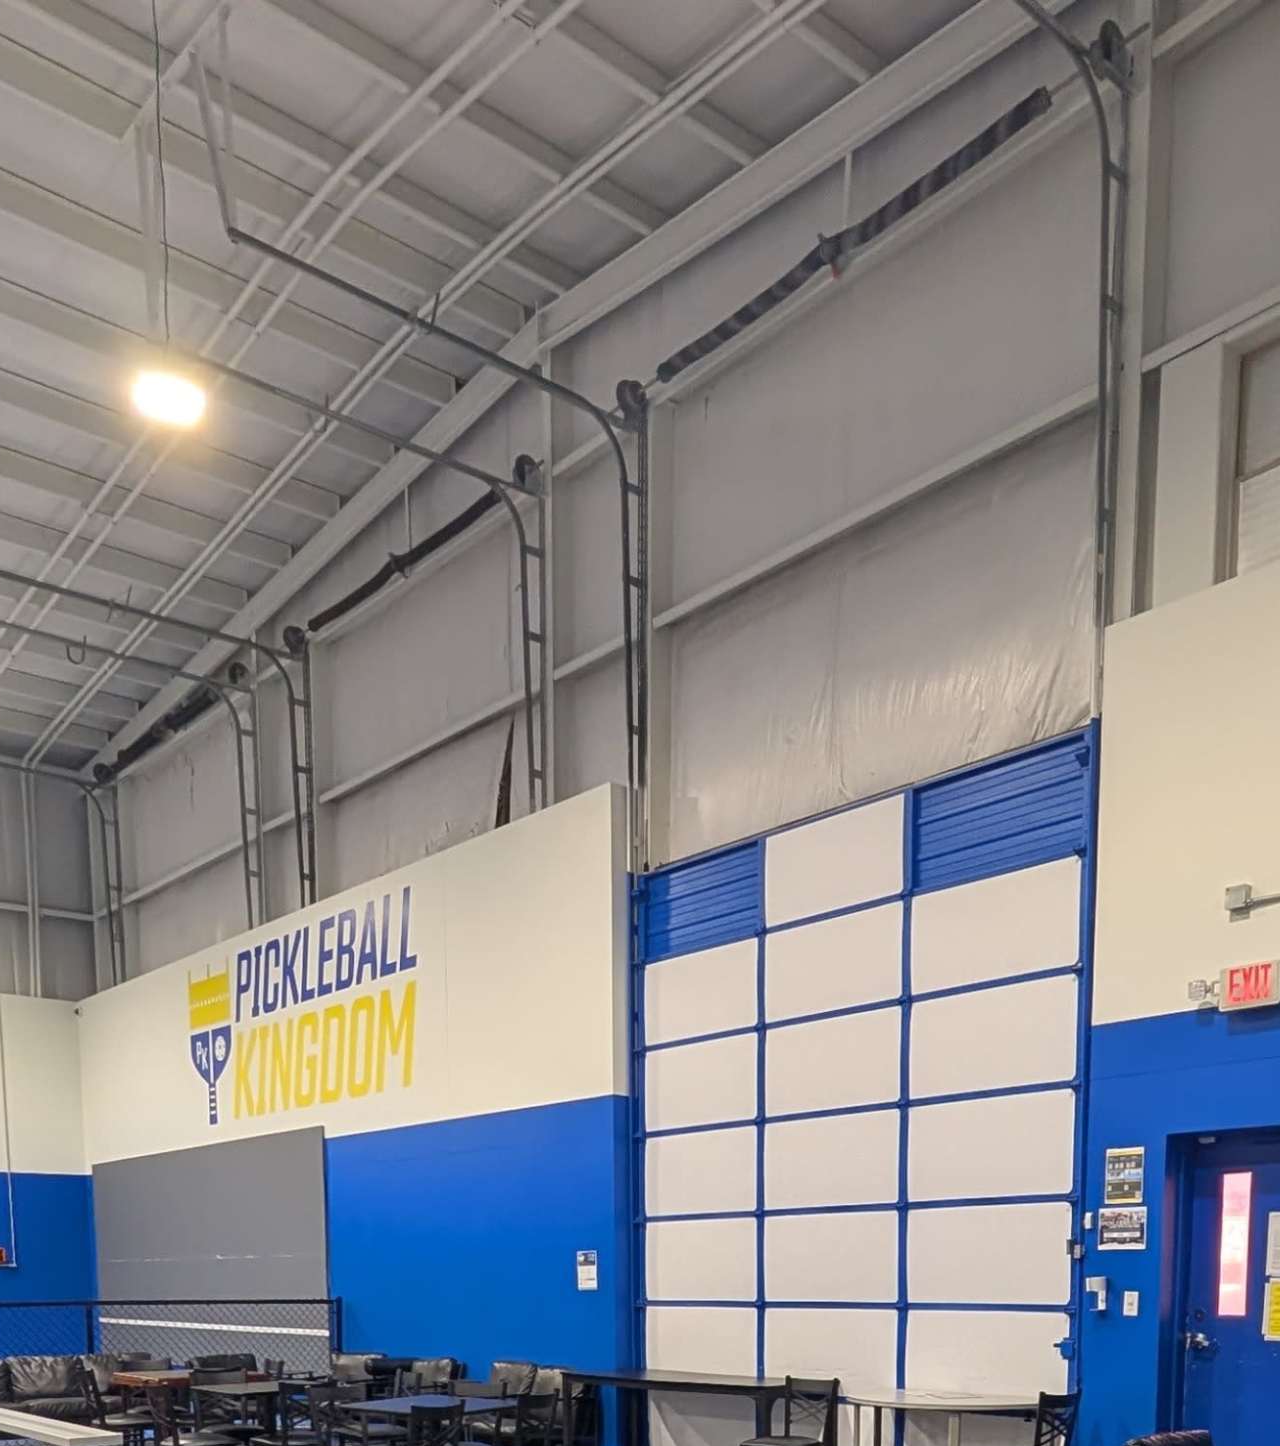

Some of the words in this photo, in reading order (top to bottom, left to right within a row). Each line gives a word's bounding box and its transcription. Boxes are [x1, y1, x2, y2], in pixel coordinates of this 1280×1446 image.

[234, 886, 418, 1023] PICKLEBALL
[1228, 963, 1273, 1002] EXIT
[195, 1041, 209, 1071] PK
[232, 980, 417, 1120] KINGDOM
